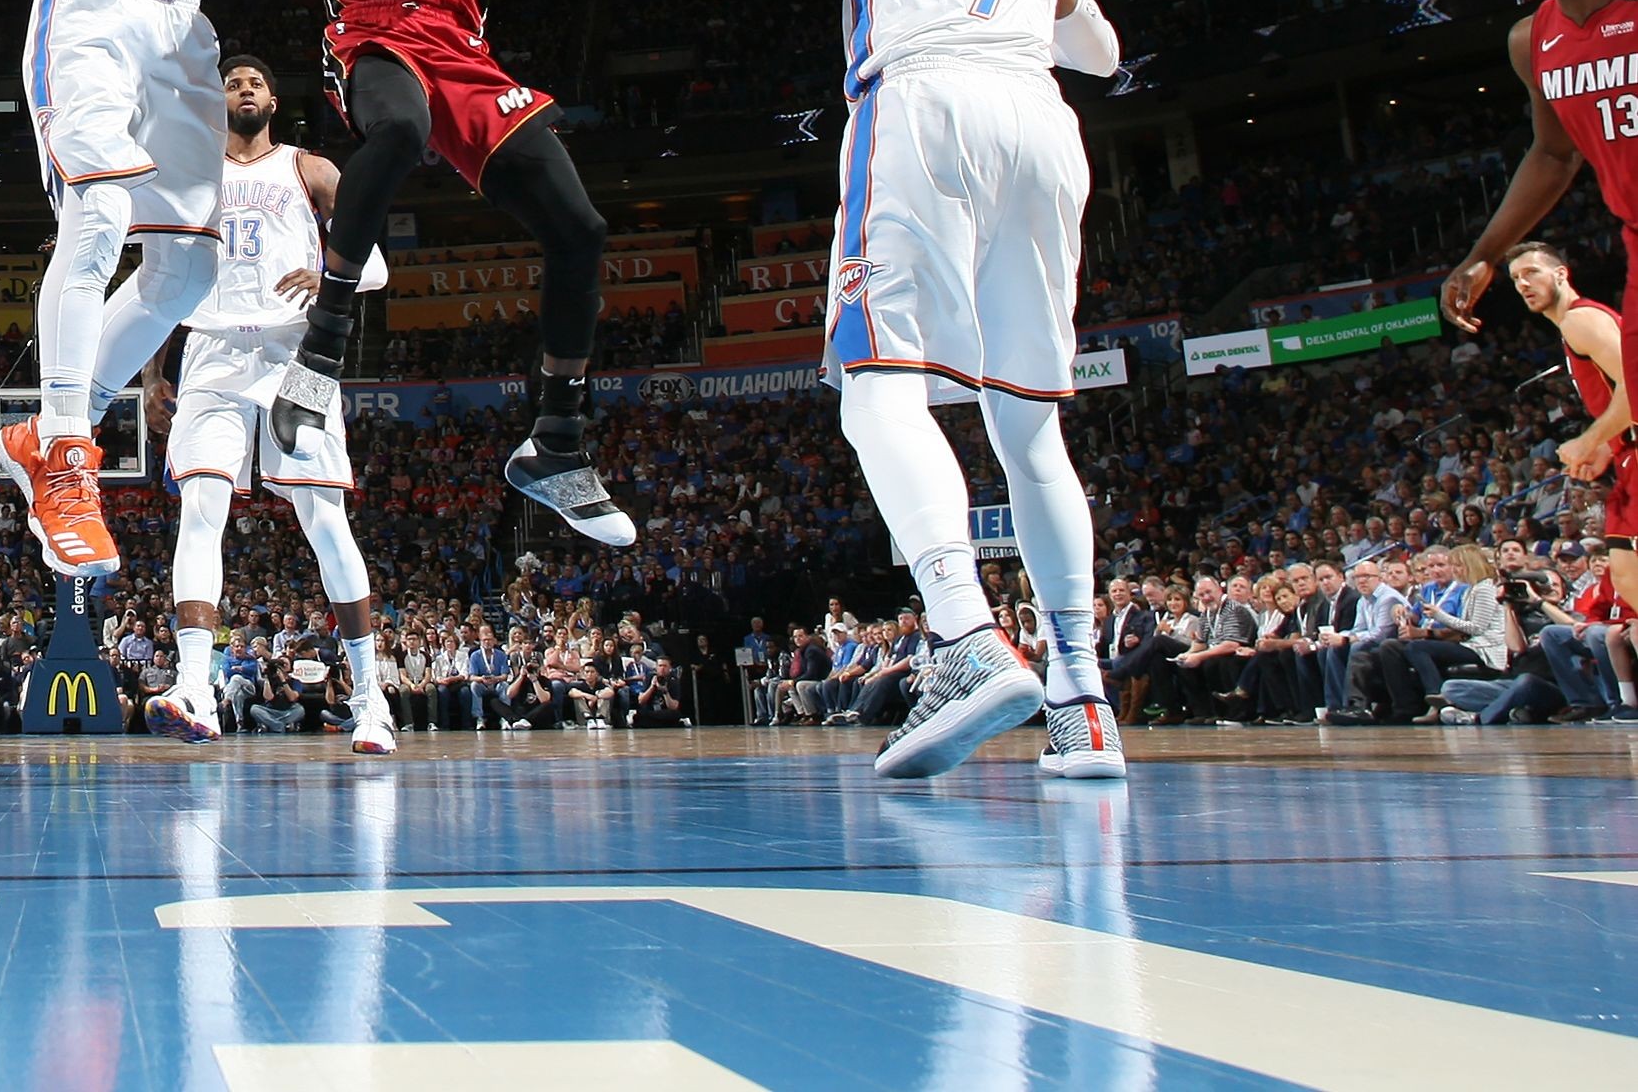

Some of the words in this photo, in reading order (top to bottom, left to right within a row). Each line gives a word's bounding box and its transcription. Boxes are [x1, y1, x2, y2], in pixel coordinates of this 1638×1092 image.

[1542, 53, 1638, 100] MIAMI
[1596, 94, 1638, 140] 13
[222, 180, 293, 218] UNDER
[222, 217, 263, 261] 13
[430, 258, 653, 292] RIVERND
[1148, 321, 1179, 338] 102
[1305, 333, 1334, 346] DELTA
[1336, 326, 1368, 342] DENTAL
[1370, 324, 1383, 335] OF
[1385, 313, 1436, 331] OKLAHOMA
[1202, 348, 1226, 359] DELTA
[1228, 345, 1260, 357] DENTAL
[591, 377, 623, 391] 102
[650, 378, 683, 395] FOX
[699, 368, 819, 398] OKLAHOMA
[1073, 362, 1111, 380] MAX
[499, 382, 526, 395] 101
